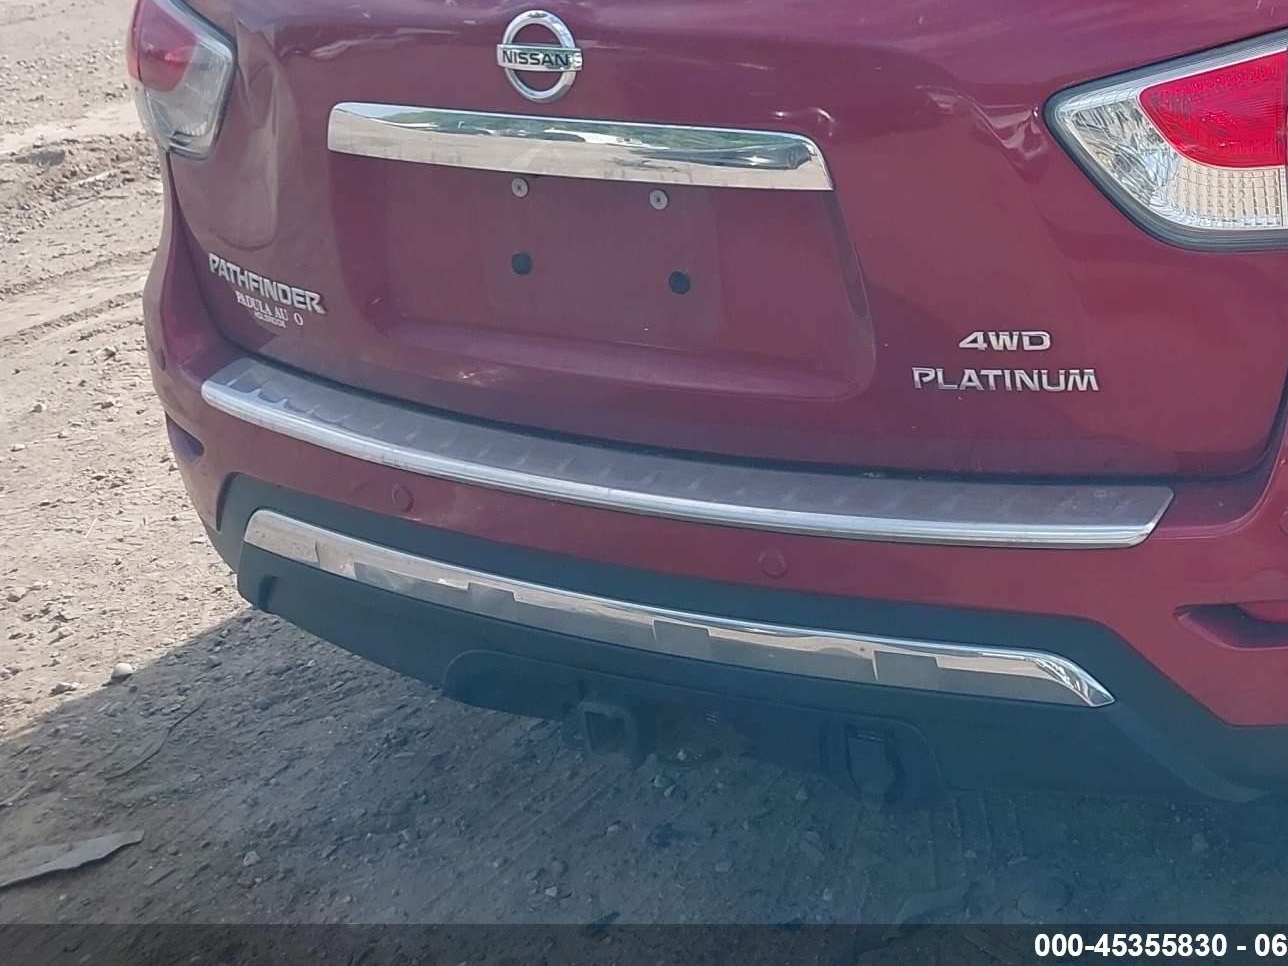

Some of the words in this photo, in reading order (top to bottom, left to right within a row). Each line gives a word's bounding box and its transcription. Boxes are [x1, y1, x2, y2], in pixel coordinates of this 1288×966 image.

[502, 50, 569, 67] NISSAN
[208, 252, 326, 315] PATHFINDER
[958, 330, 1052, 352] 4WD
[911, 367, 1100, 392] PLATINUM
